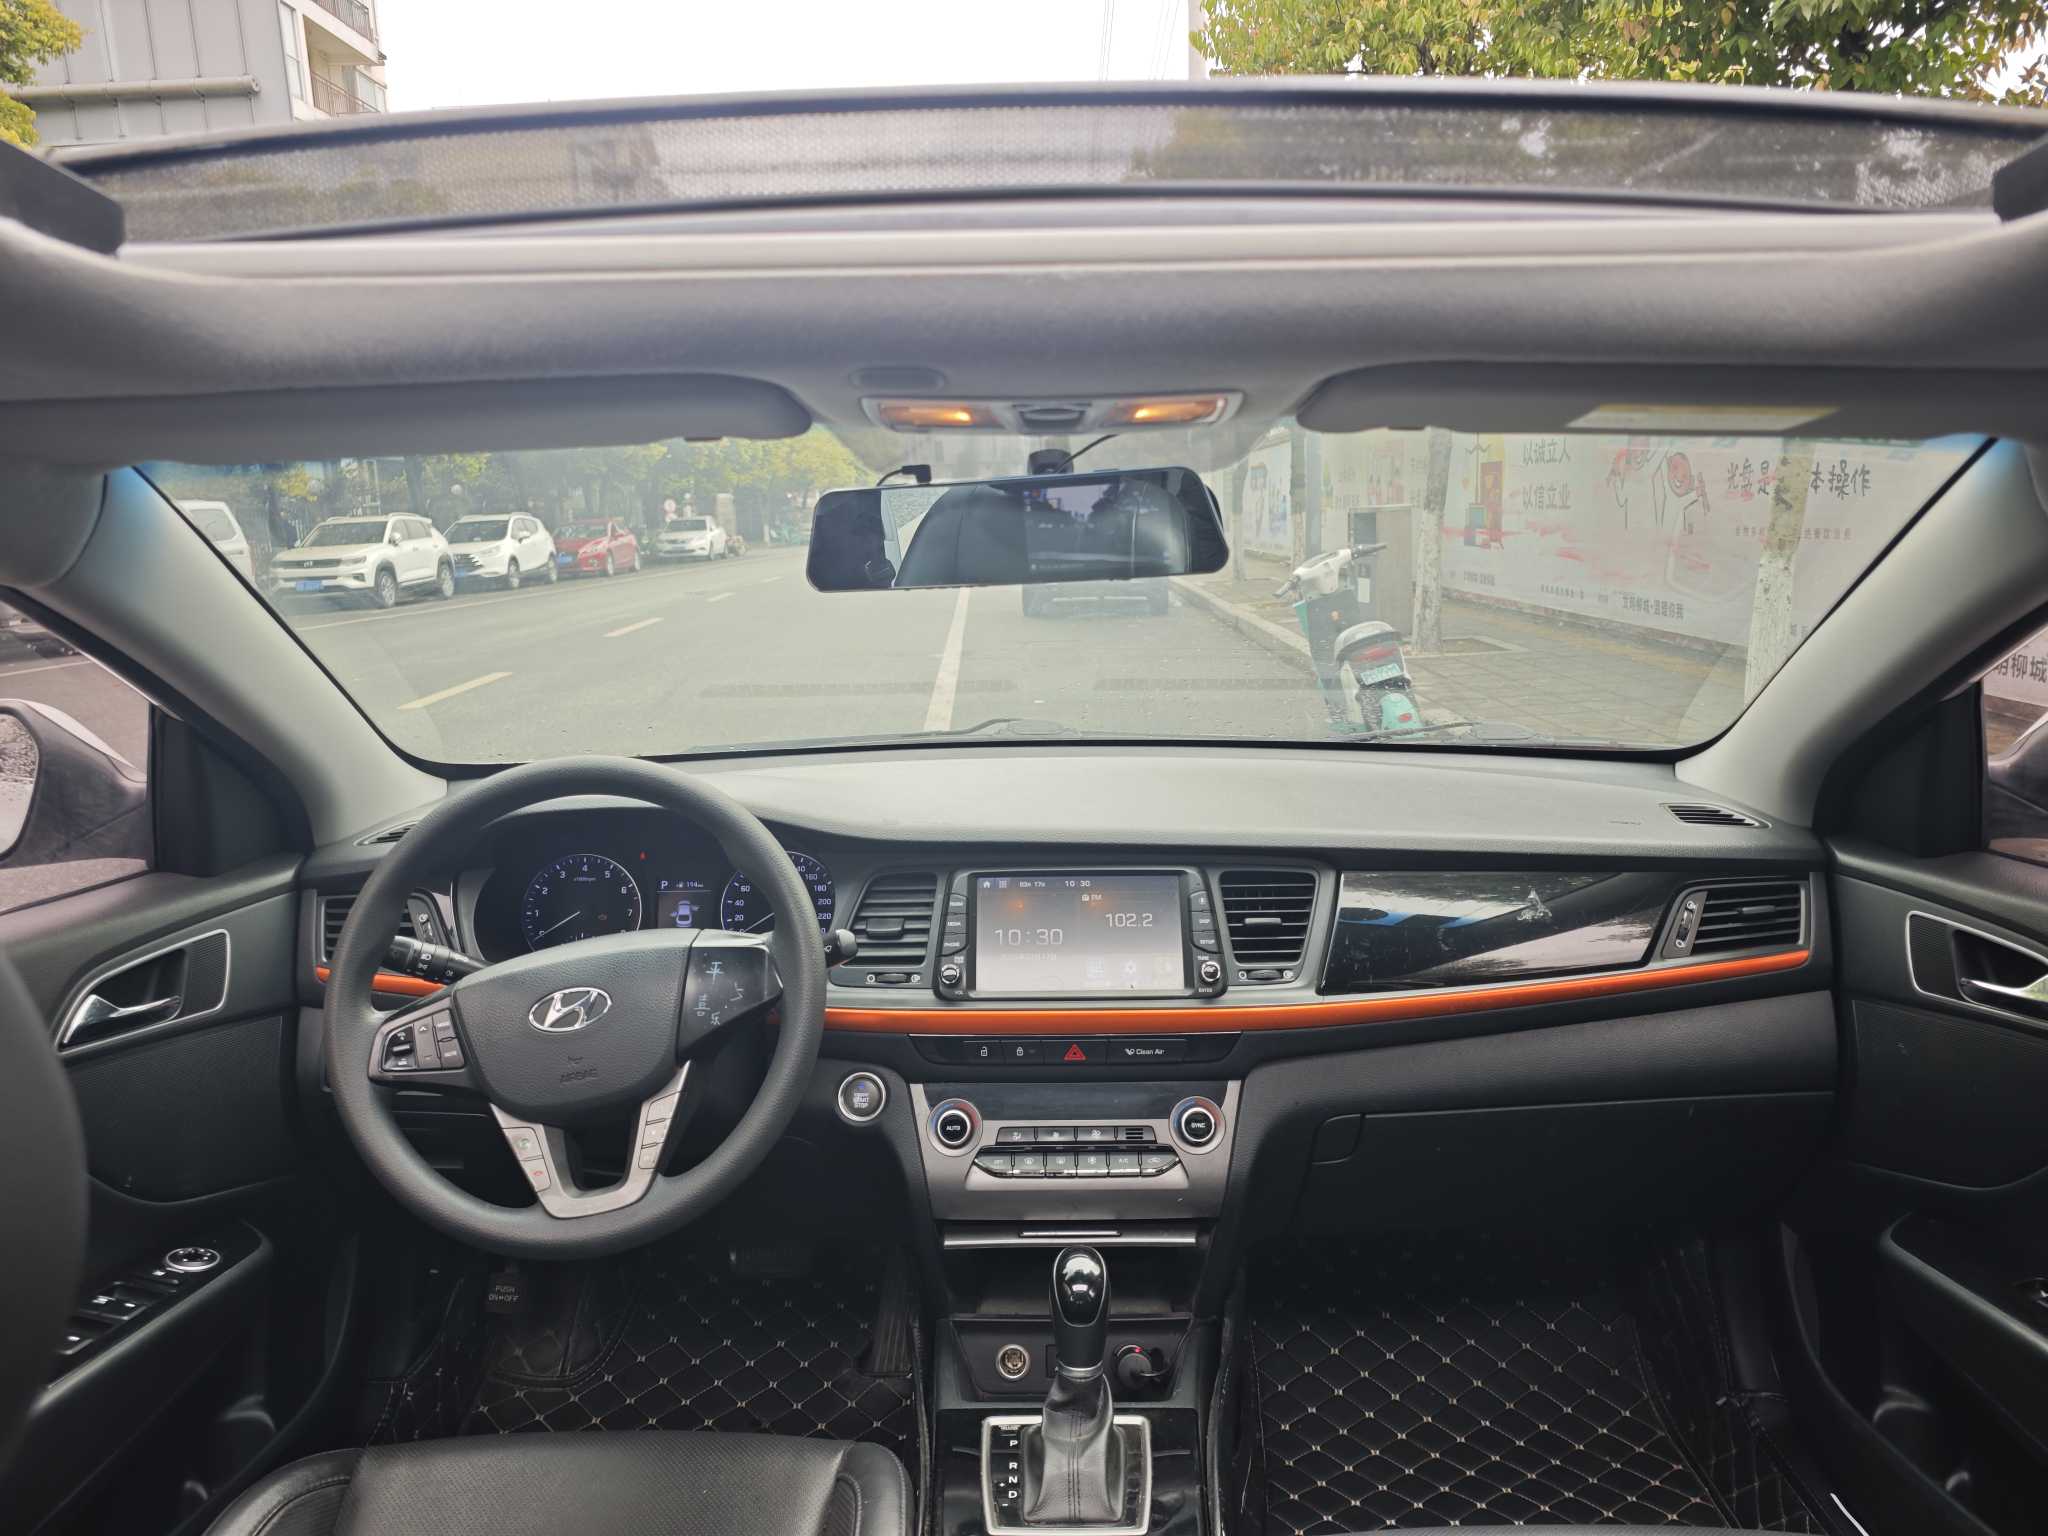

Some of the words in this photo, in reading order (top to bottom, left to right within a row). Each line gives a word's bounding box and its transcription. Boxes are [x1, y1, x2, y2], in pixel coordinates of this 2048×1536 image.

[1522, 437, 1570, 466] 以诚立人
[1727, 458, 1872, 500] 光盘是本操作
[1522, 482, 1571, 509] 以信立业
[559, 871, 566, 879] 3
[604, 871, 611, 879] 5
[661, 881, 668, 889] P
[541, 887, 548, 895] 2
[620, 886, 627, 894] 6
[1105, 913, 1153, 928] 102.2
[994, 928, 1063, 946] 10:30
[1008, 1490, 1018, 1499] D
